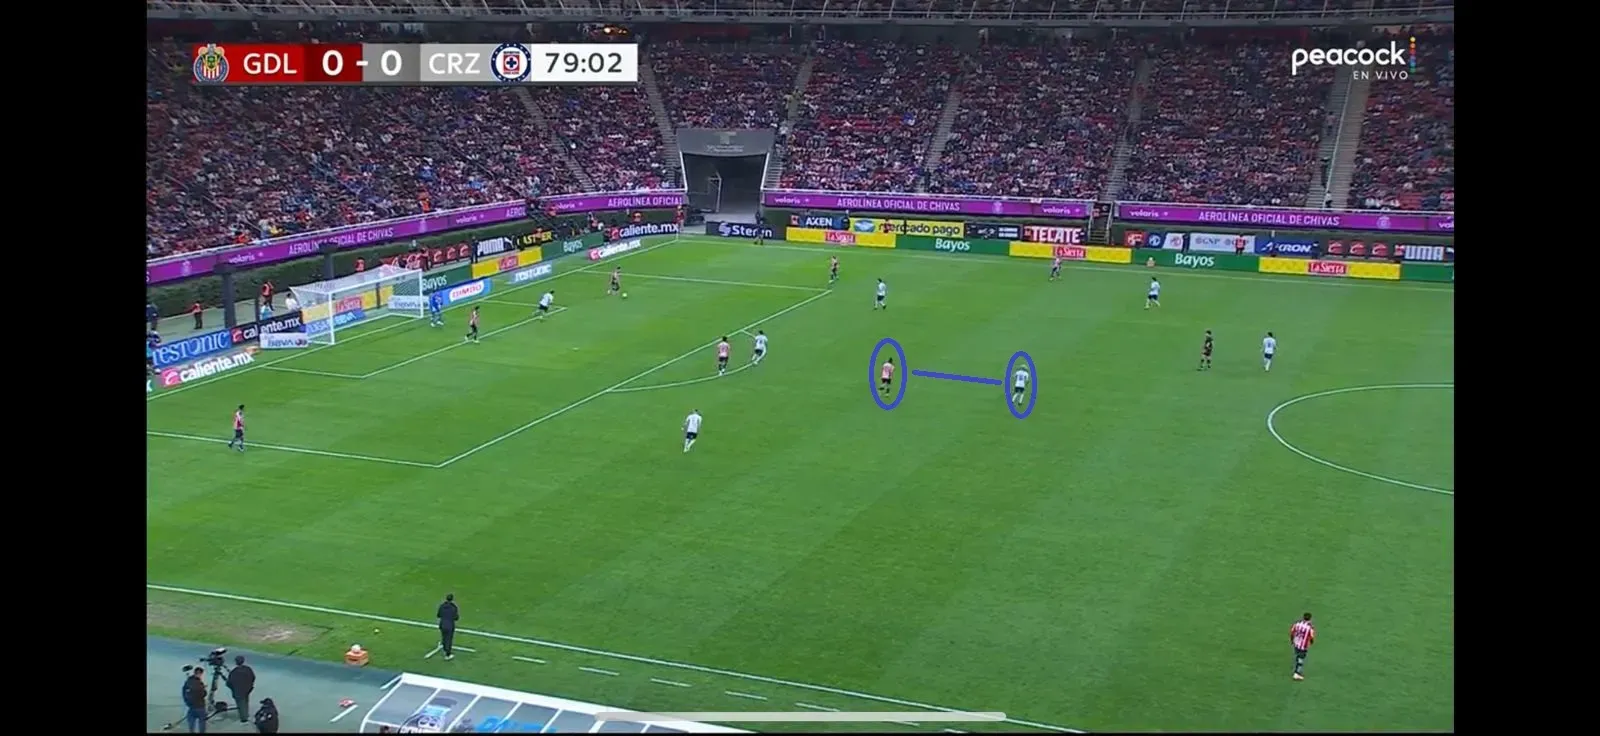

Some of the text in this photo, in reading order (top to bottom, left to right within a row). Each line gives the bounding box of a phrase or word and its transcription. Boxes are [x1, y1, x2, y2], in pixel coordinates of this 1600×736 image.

[774, 196, 960, 211] volaris AEROLÍNEA OFICIAL DE CHIVAS
[1042, 206, 1071, 214] volaris
[805, 216, 832, 226] AXEN
[1130, 209, 1340, 226] volaris AEROLÍNEA OFICIAL DE CHIVAS
[620, 222, 679, 239] caliente.mx
[732, 225, 773, 238] Stern
[932, 225, 960, 237] pago
[1031, 226, 1081, 243] TECATE
[477, 238, 504, 255] PUMA
[935, 238, 971, 252] Bayos
[1402, 244, 1445, 261] UMA
[1174, 253, 1215, 268] Bayos
[1320, 262, 1345, 274] Sierra
[180, 351, 255, 383] caliente.mx
